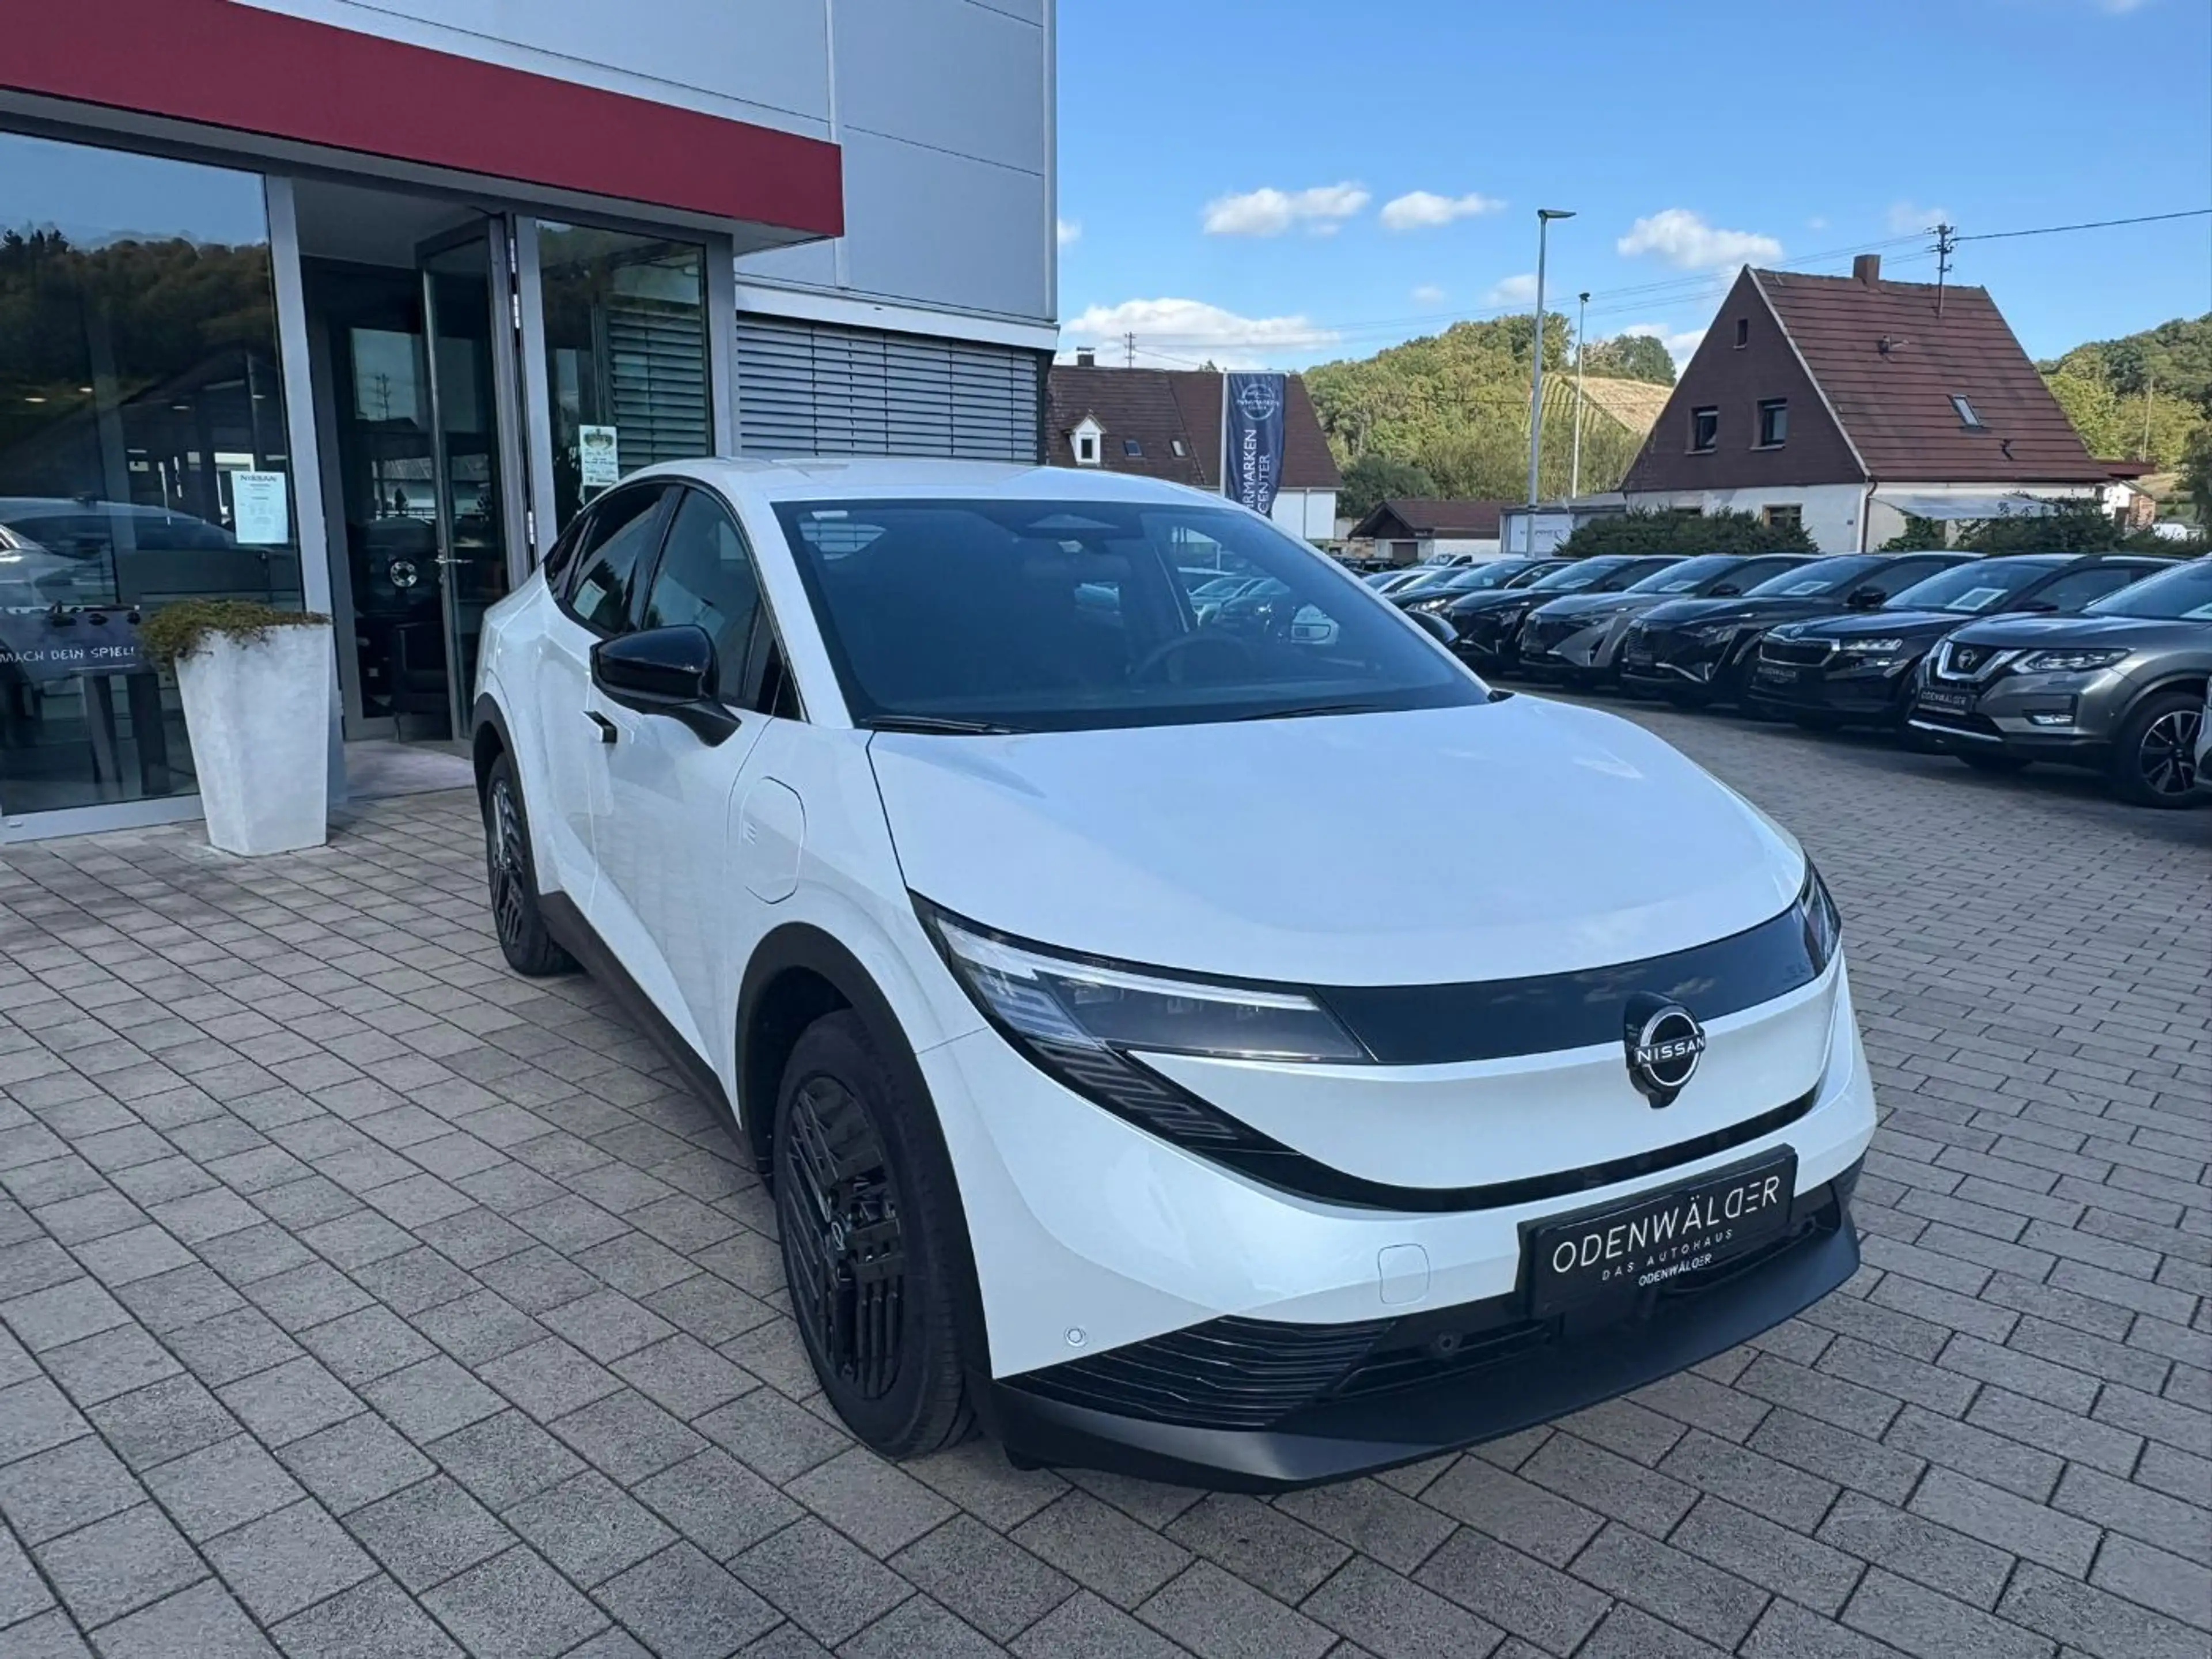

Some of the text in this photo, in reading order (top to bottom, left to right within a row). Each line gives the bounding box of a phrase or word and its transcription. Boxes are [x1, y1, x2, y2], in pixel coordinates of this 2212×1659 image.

[1257, 453, 1270, 514] CENTER
[0, 646, 134, 663] MACH DEIN SPIEL!
[1638, 1036, 1705, 1063] NISSAN
[1552, 1175, 1780, 1273] ODENWÄLDER
[1601, 1228, 1733, 1281] DAS AUTOHAUS
[1638, 1253, 1713, 1287] ODENWÄLDER
